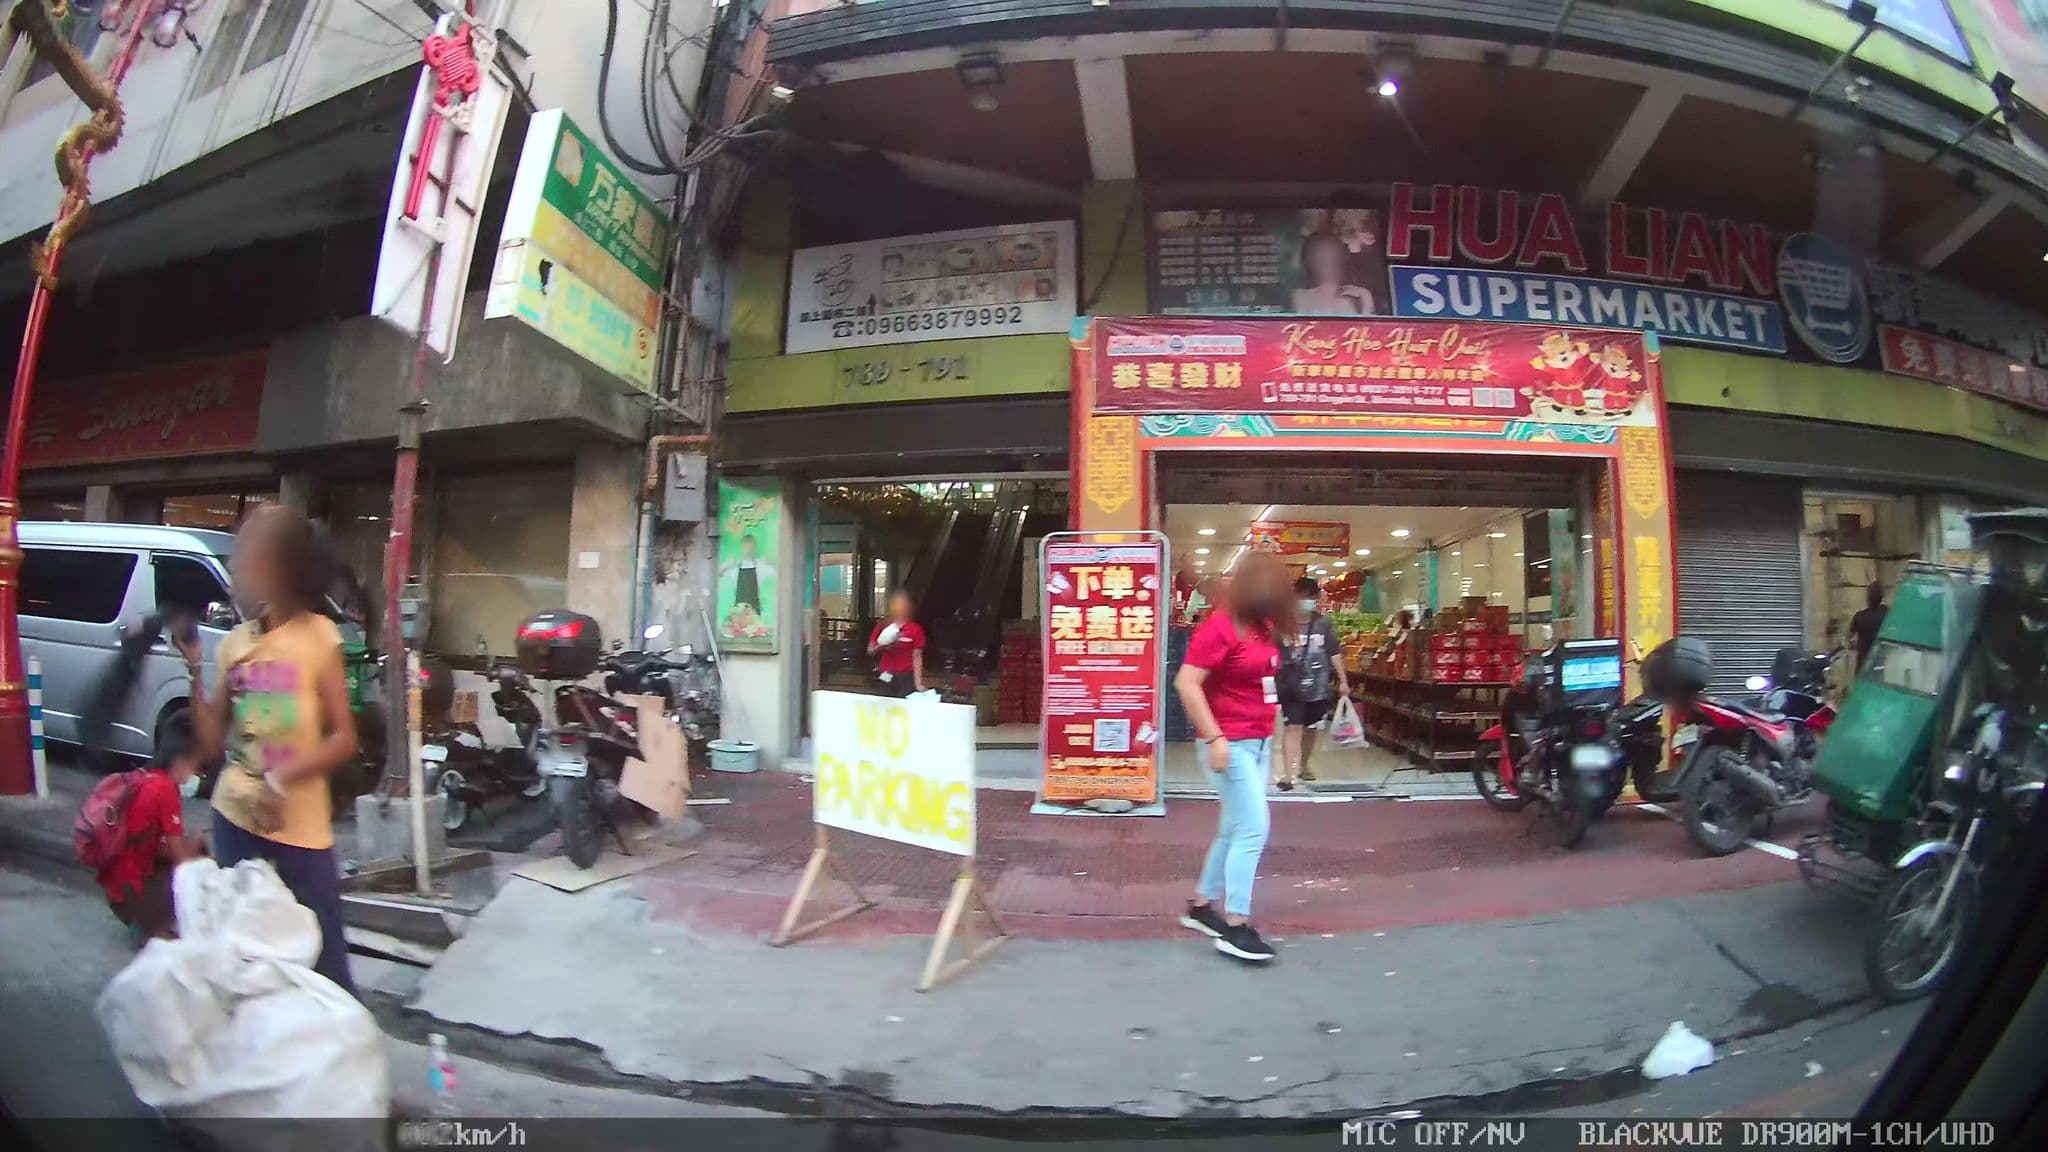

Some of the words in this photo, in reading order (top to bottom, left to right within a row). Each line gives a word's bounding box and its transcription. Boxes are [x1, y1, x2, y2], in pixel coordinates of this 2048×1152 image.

[1386, 182, 1588, 272] HUA
[1606, 202, 1772, 295] LIAN
[1340, 326, 1381, 360] Hee
[1412, 272, 1767, 344] SUPERMARKET
[855, 703, 912, 759] NO
[817, 751, 971, 843] PARKING
